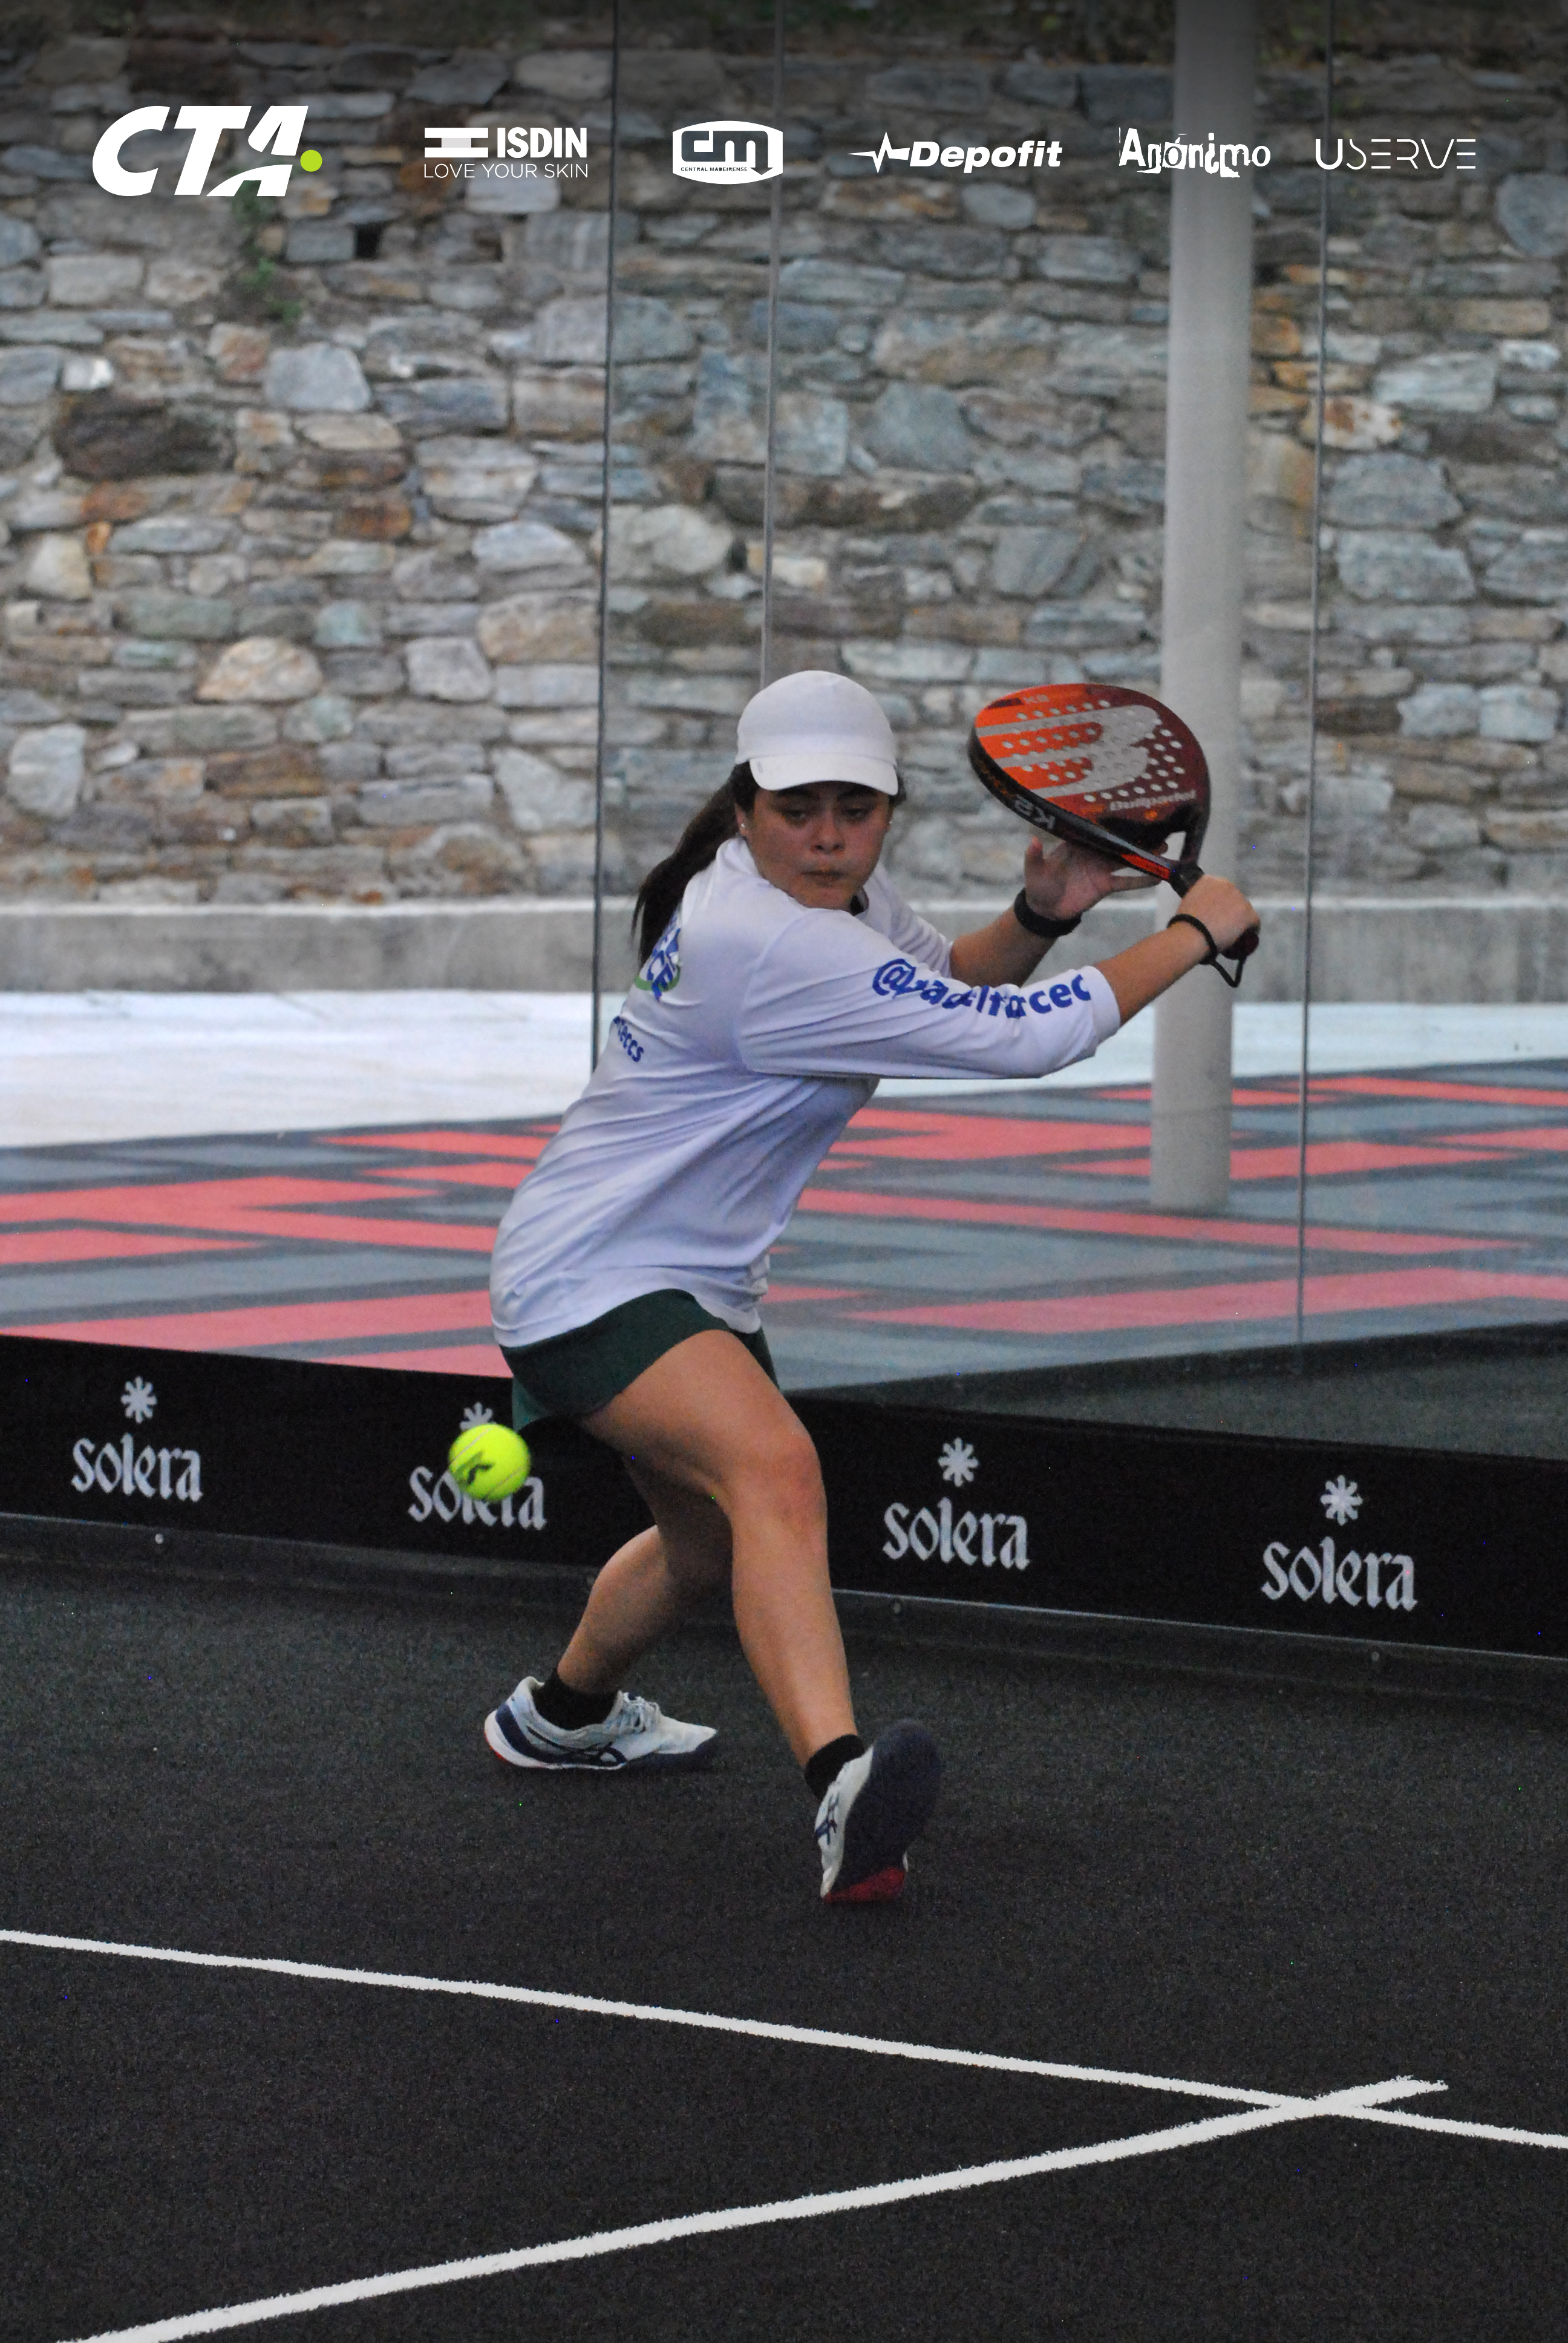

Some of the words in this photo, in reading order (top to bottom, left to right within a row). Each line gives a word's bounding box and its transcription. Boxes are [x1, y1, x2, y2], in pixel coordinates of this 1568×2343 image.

[71, 1433, 203, 1502] solera
[882, 1497, 1030, 1570] solera
[1261, 1536, 1418, 1612] solera
